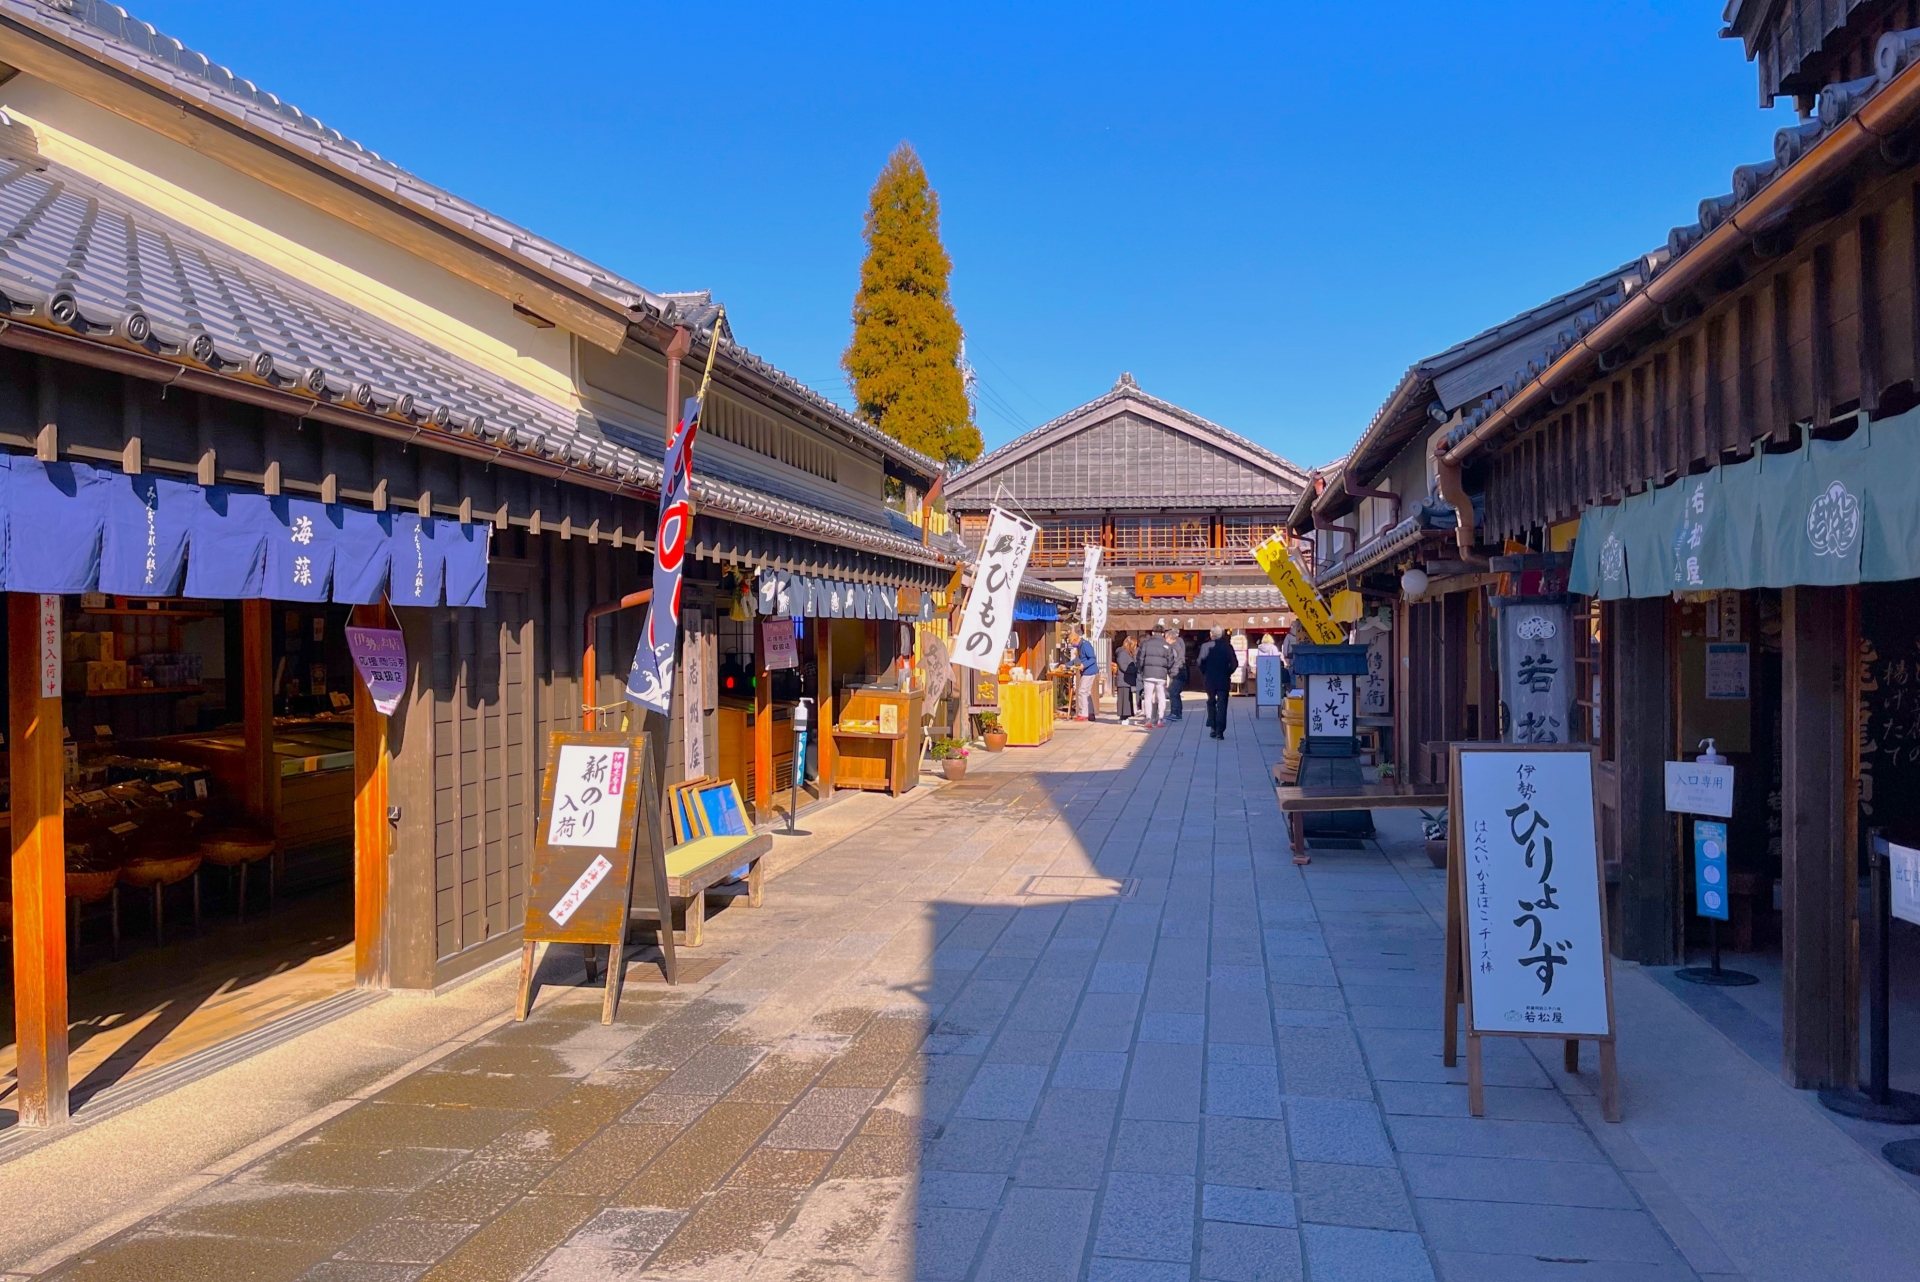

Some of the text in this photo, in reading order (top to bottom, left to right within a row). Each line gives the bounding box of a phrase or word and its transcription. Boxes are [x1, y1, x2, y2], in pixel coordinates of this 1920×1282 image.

[291, 516, 314, 587] 海藻
[1687, 482, 1704, 585] 若松屋
[45, 596, 57, 695] 新海苔入荷中
[966, 563, 1010, 657] ひもの
[371, 671, 402, 682] 取扱店
[1325, 675, 1349, 729] 横丁そば
[1883, 660, 1908, 766] 揚げたて
[556, 794, 579, 837] 入荷
[581, 754, 608, 837] 新のり
[1676, 773, 1723, 789] 入口専用
[1525, 1011, 1563, 1024] 若松屋
